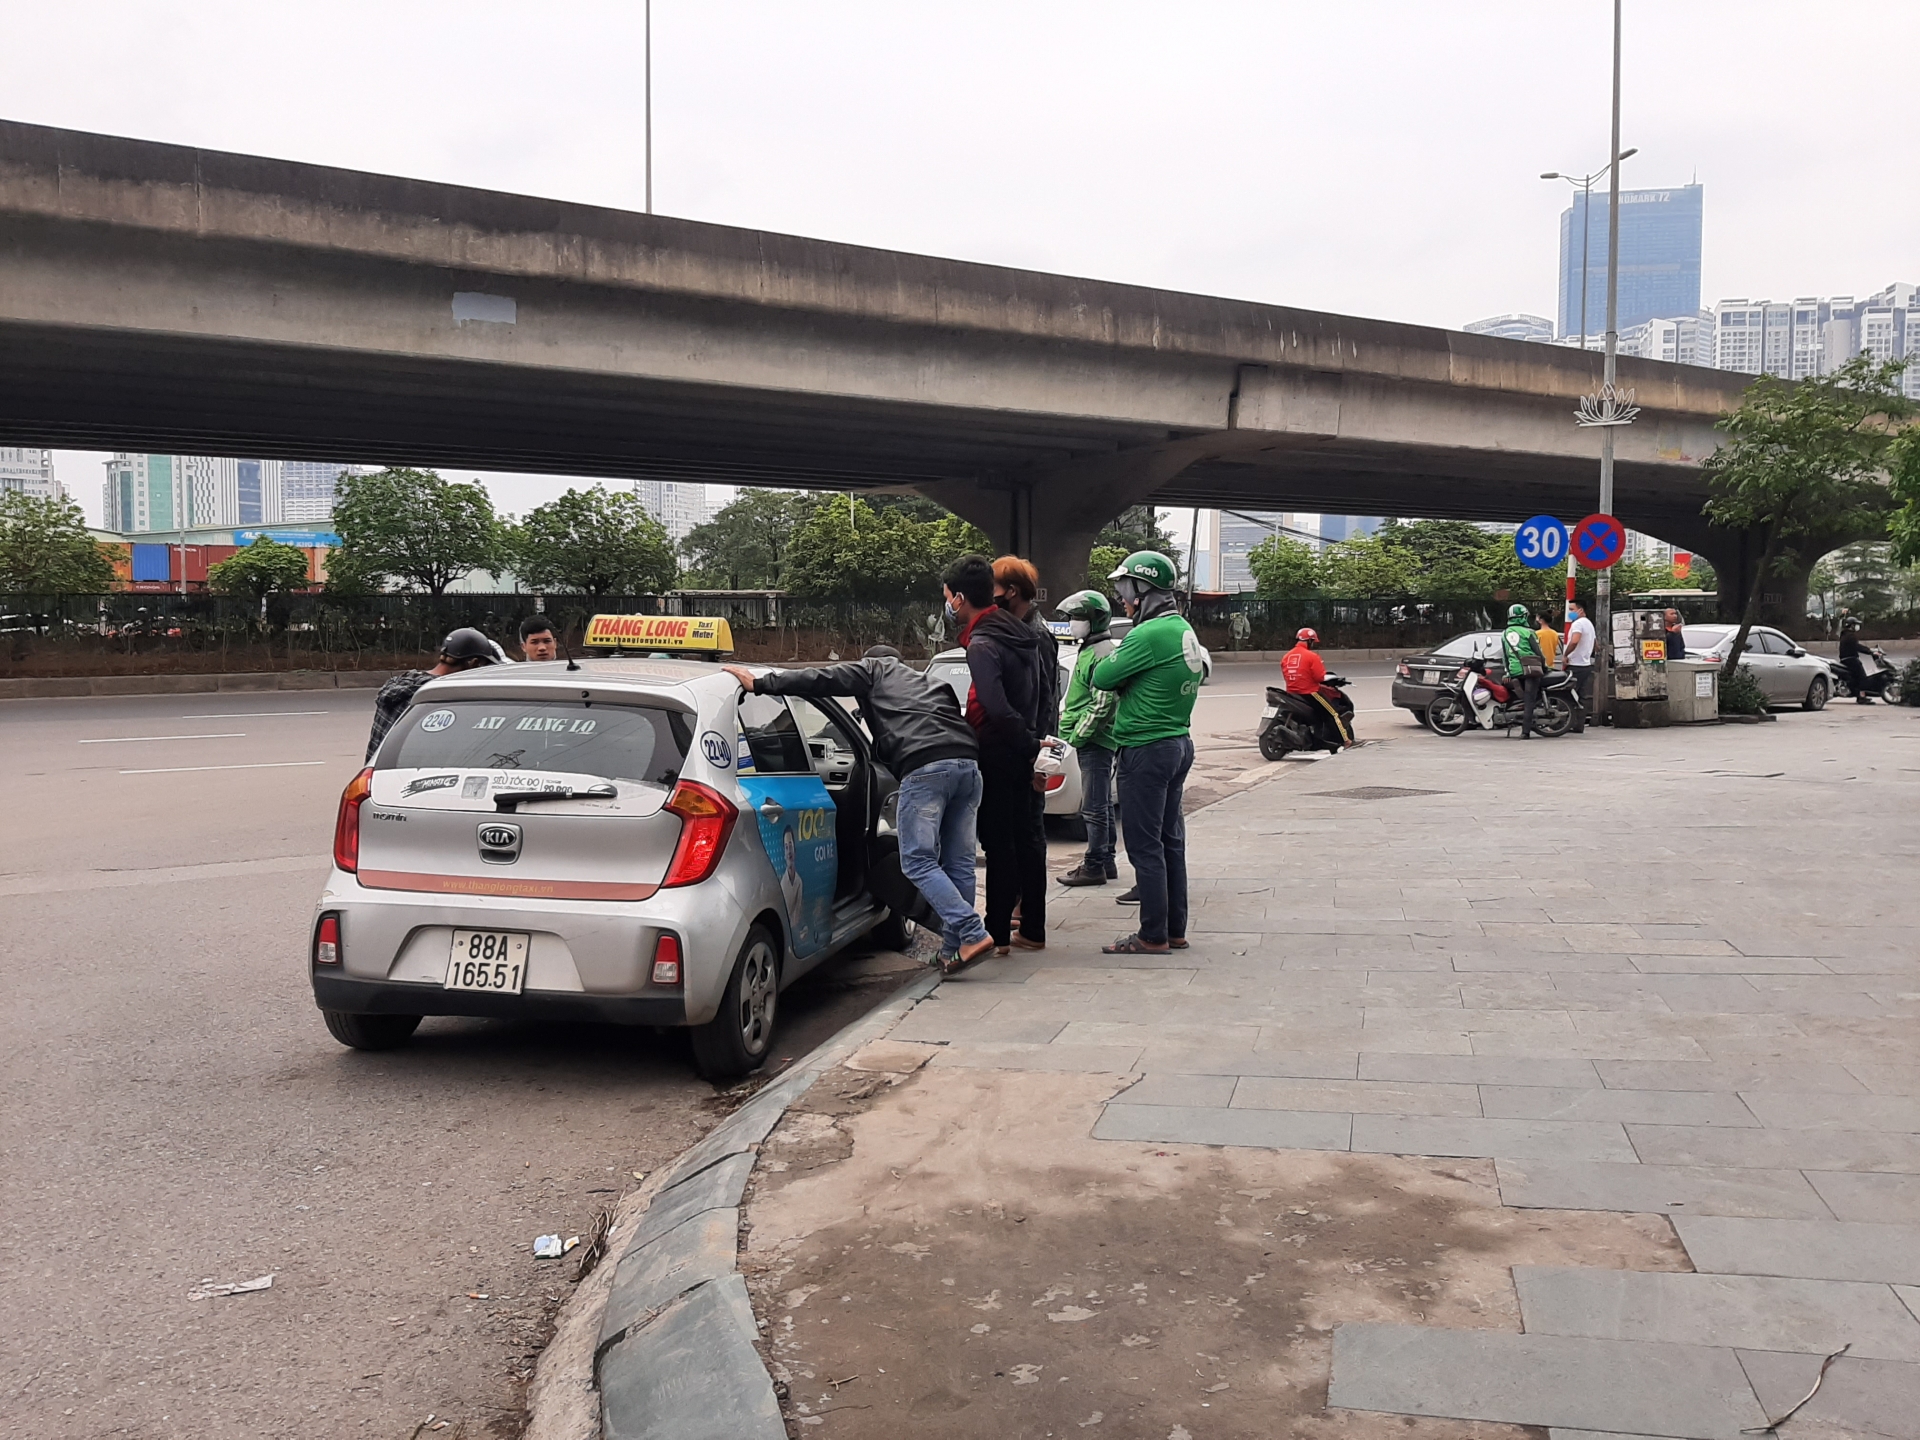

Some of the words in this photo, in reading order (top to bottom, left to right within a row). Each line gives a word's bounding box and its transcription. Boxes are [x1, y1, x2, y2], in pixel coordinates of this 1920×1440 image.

[1607, 194, 1656, 204] NDMARK
[1659, 192, 1670, 202] 72
[1522, 527, 1560, 558] 30
[1134, 564, 1158, 578] Grab
[646, 619, 689, 637] LONG
[692, 630, 714, 639] Meter
[424, 714, 451, 728] 2240
[704, 740, 730, 762] 2240
[485, 832, 510, 843] KIA
[442, 879, 553, 894] www.thanglongtaxi.vn
[469, 934, 508, 961] 88A
[453, 962, 520, 990] 165.51
